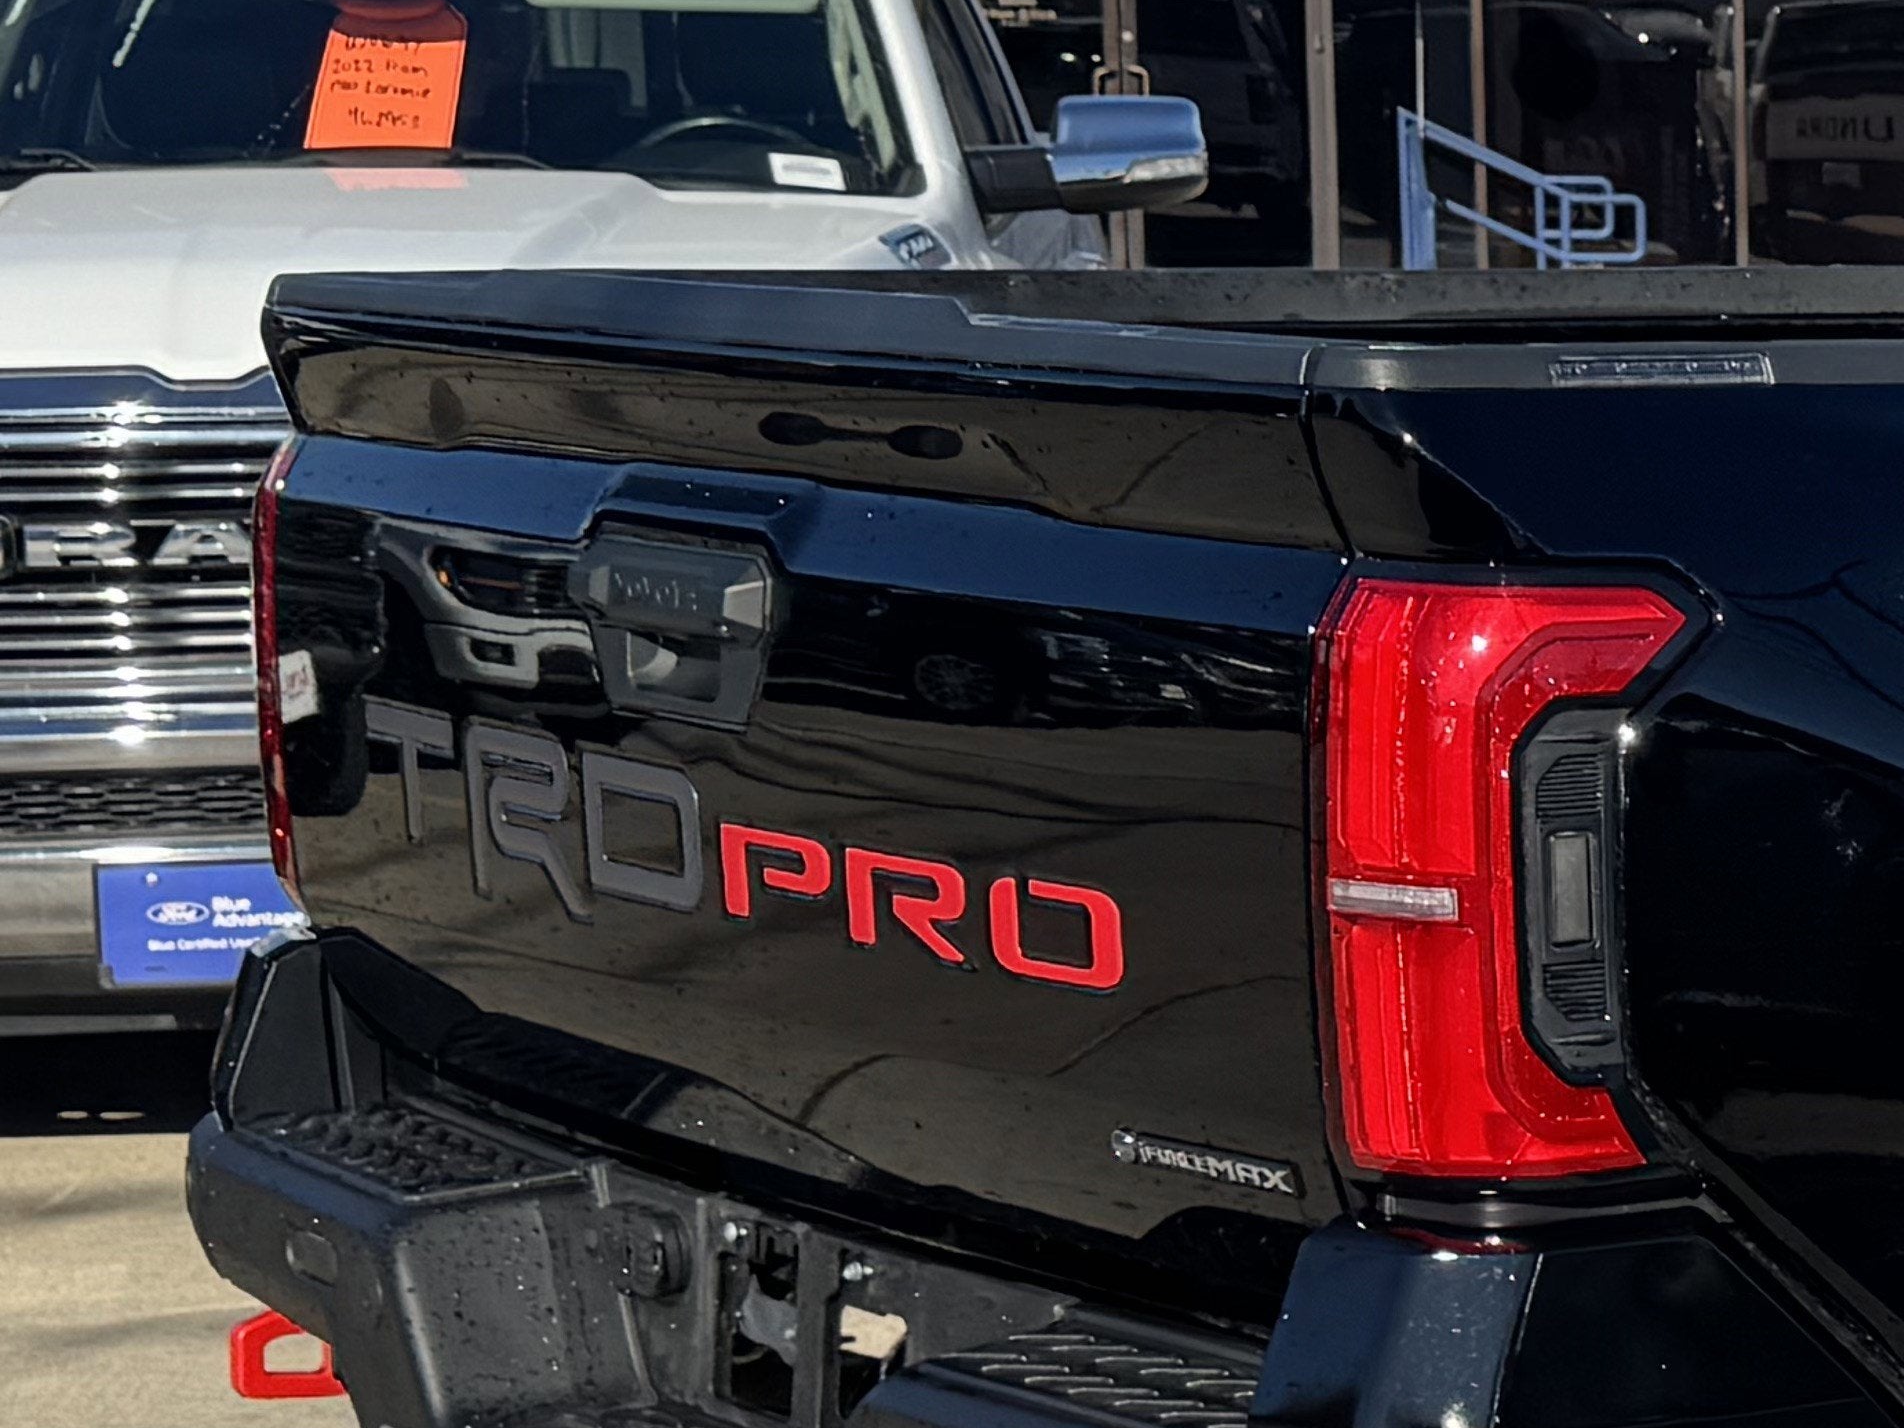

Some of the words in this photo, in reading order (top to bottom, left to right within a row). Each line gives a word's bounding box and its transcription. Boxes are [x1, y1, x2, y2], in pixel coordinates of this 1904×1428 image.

[23, 521, 252, 568] RA
[361, 691, 704, 924] TRD
[718, 821, 1125, 992] PRO
[211, 896, 251, 912] Blue
